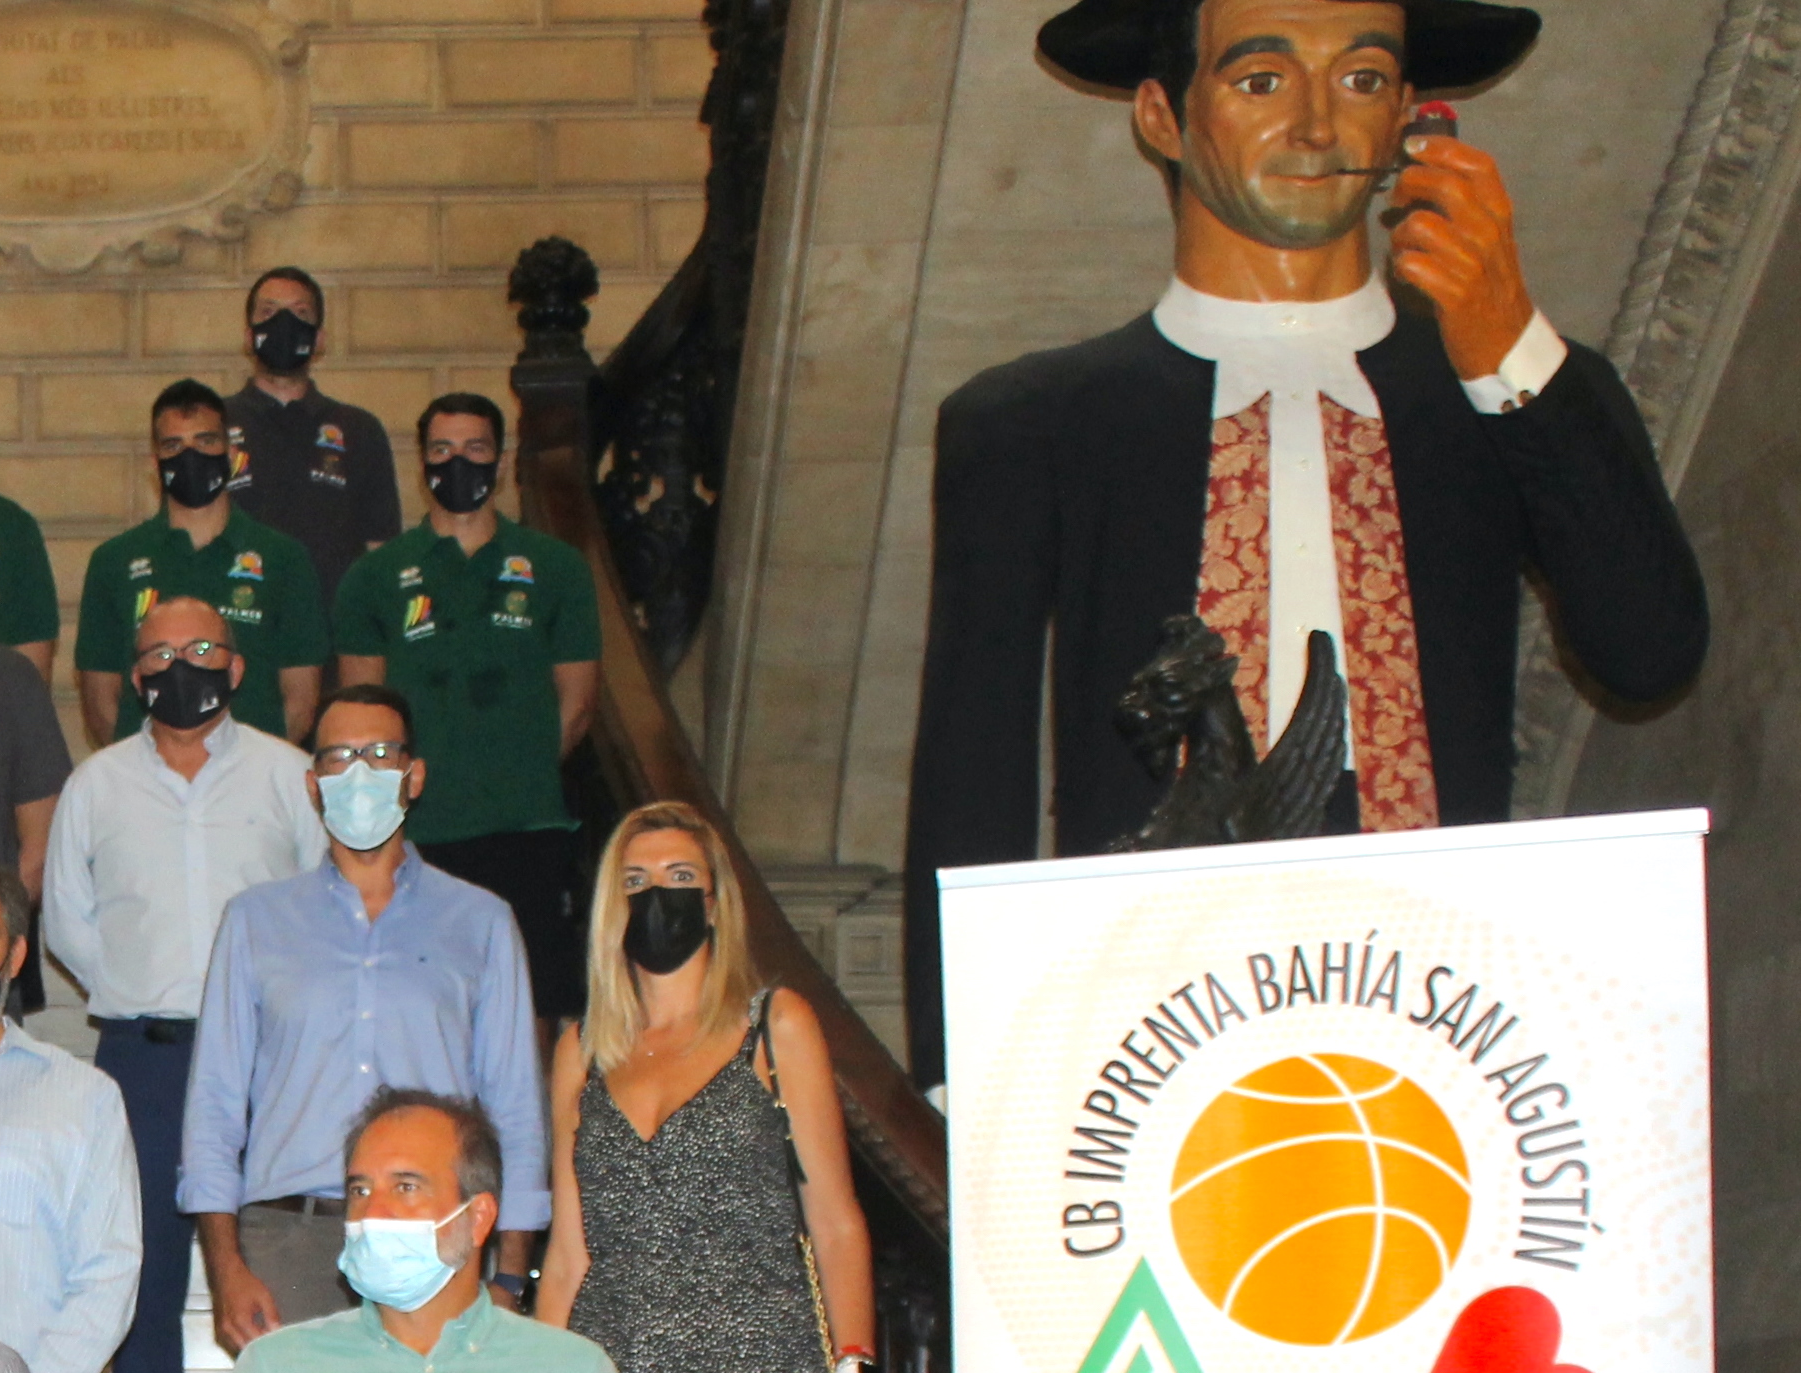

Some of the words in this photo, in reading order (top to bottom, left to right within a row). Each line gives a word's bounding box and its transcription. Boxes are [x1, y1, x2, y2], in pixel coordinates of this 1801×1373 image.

[1246, 928, 1404, 1016] BAHÍA
[1406, 964, 1523, 1067] SAN
[1063, 970, 1251, 1185] IMPRENTA
[1482, 1051, 1606, 1273] AGUSTÍN
[1062, 1197, 1127, 1260] CB
